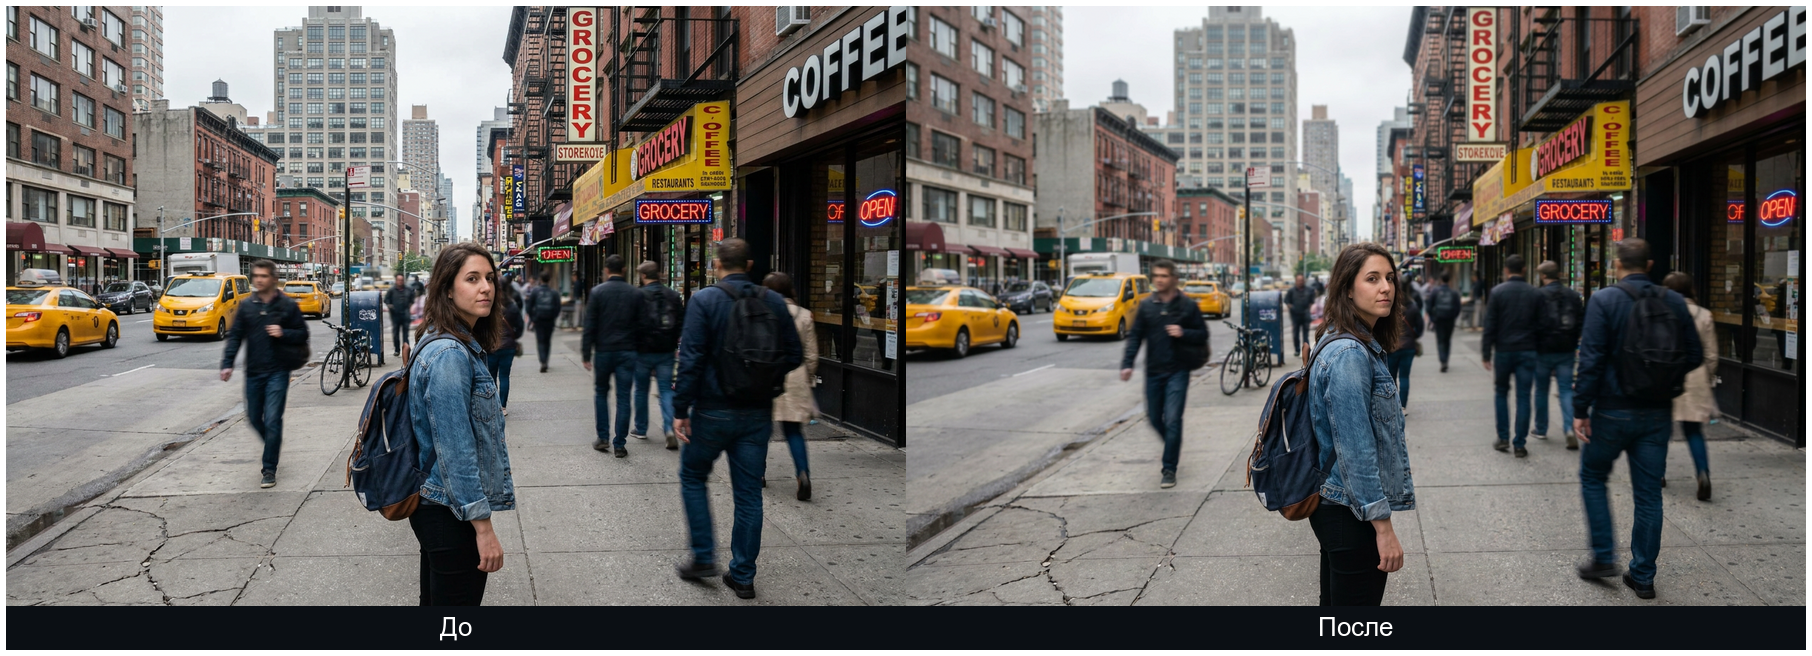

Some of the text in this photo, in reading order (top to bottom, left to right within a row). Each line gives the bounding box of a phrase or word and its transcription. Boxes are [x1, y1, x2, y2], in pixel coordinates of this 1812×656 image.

[783, 6, 906, 118] COFFEE
[1683, 6, 1806, 118] COFFEE
[572, 11, 593, 138] GROCERY
[1472, 11, 1493, 138] GROCERY
[638, 116, 687, 177] GROCERY
[1538, 116, 1587, 177] GROCERY
[652, 178, 694, 188] RESTAURANTS
[1552, 178, 1594, 188] RESTAURANTS
[639, 203, 709, 220] GROCERY
[860, 196, 896, 220] OPEN
[1539, 203, 1609, 220] GROCERY
[1760, 196, 1796, 220] OPEN
[541, 250, 571, 260] OPEN
